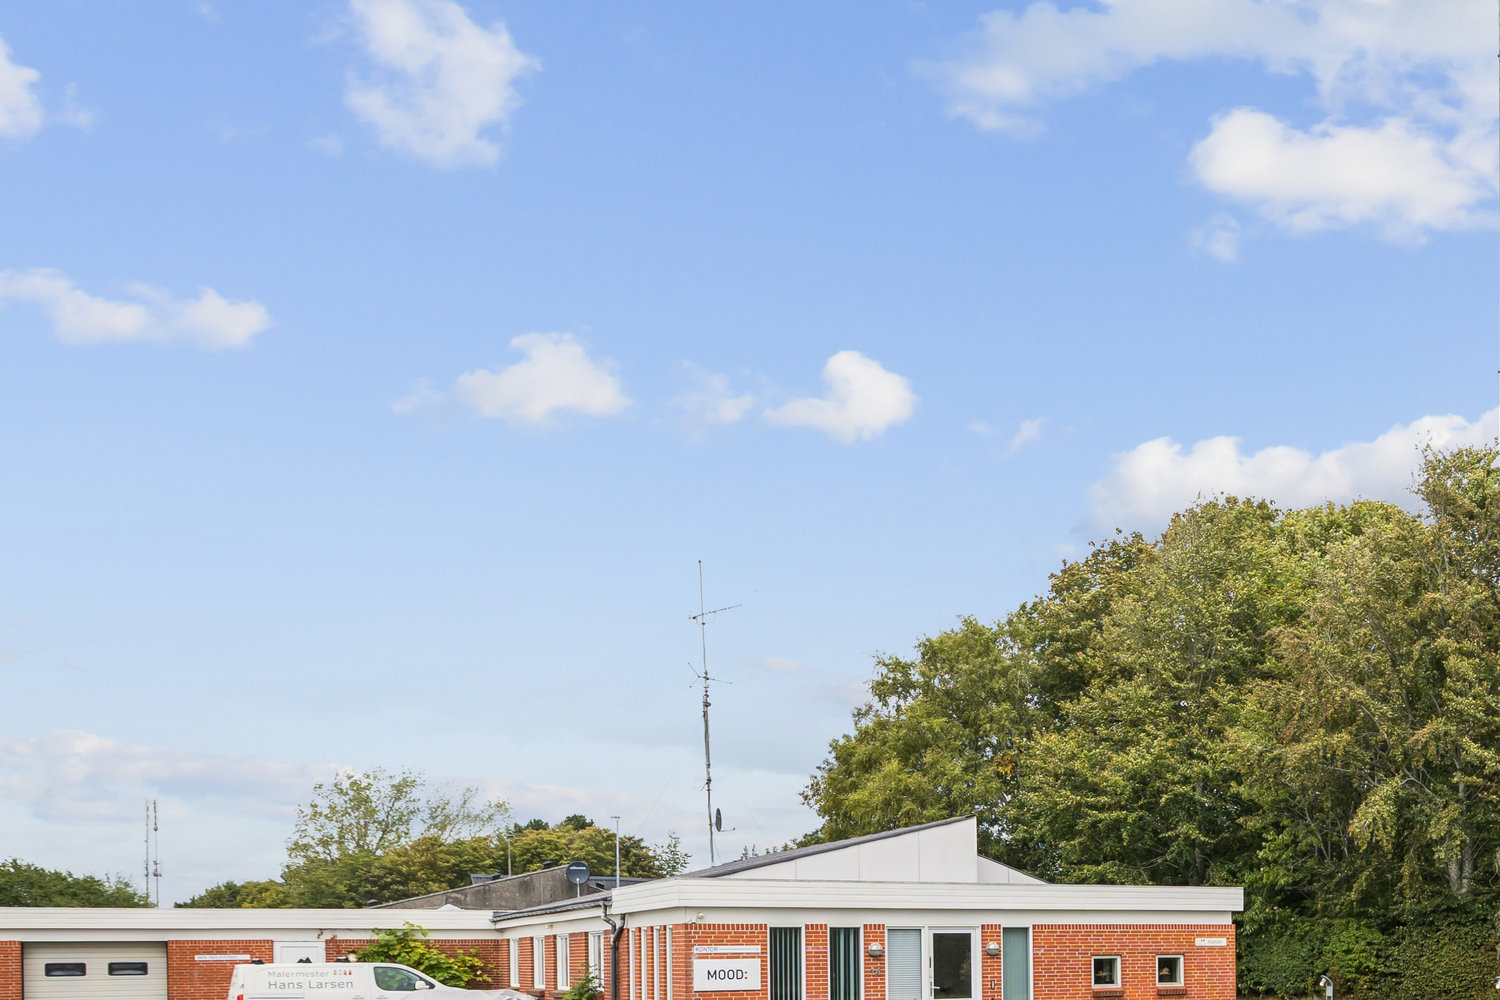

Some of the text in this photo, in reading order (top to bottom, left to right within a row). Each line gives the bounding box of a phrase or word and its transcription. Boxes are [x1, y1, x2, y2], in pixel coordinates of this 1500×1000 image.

[707, 969, 748, 980] MOOD:
[268, 980, 354, 990] Hans Larsen
